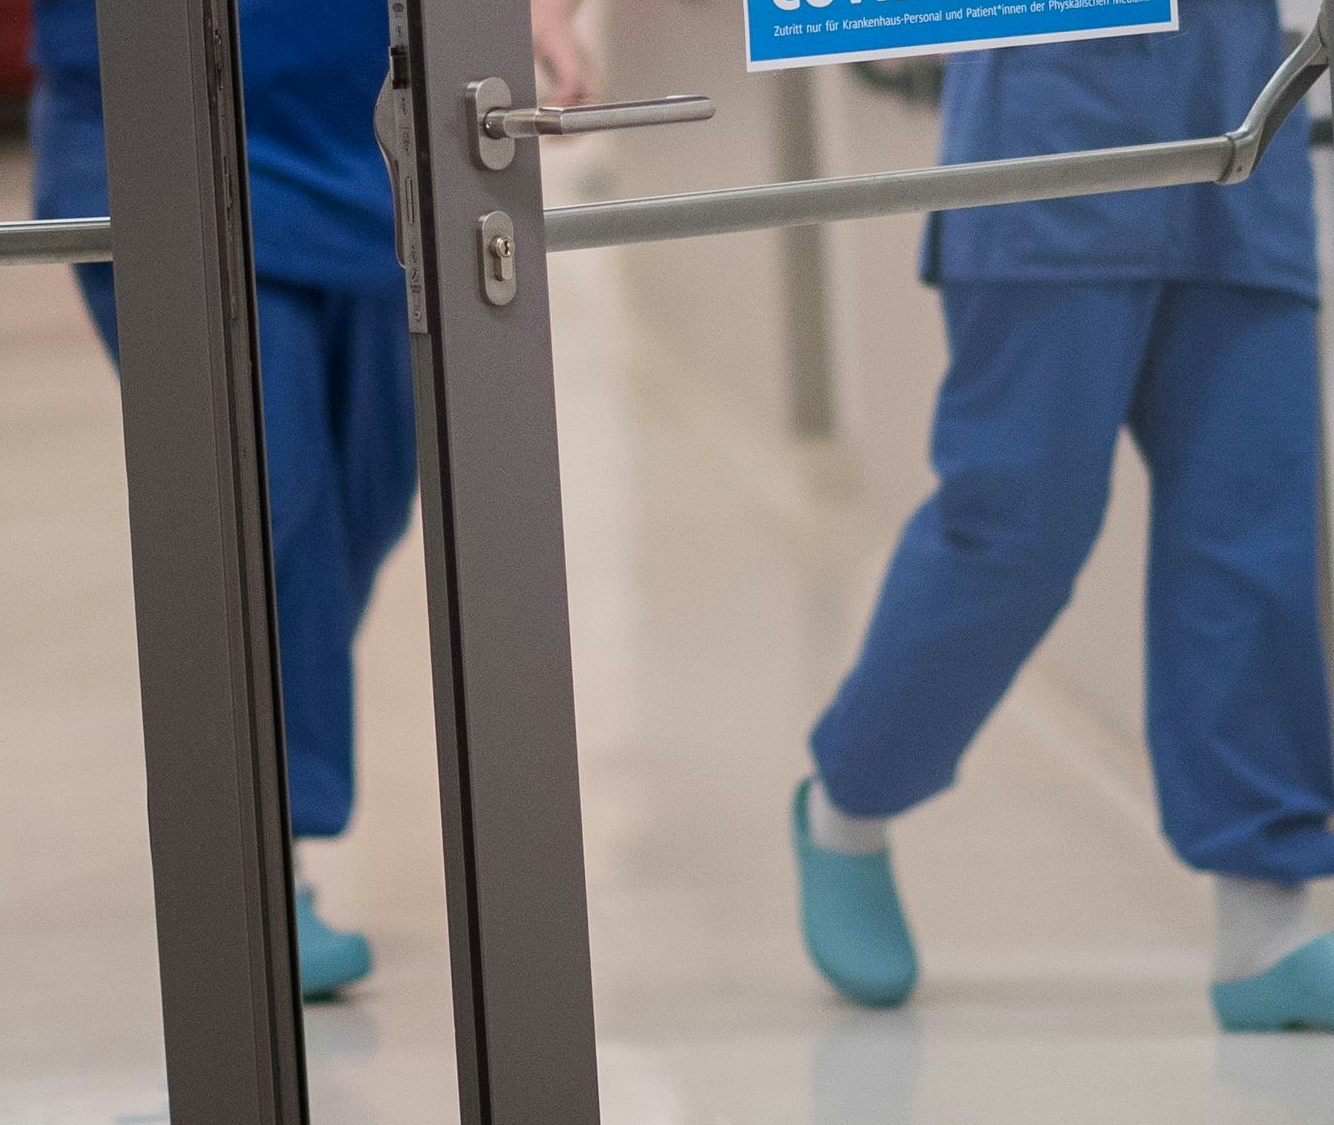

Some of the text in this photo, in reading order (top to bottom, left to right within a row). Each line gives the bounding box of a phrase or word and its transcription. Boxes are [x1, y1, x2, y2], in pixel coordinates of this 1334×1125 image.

[774, 25, 803, 37] Zutritt
[807, 23, 822, 33] nur
[826, 20, 839, 32] für
[843, 11, 942, 29] Krankenhaus-Personal
[946, 8, 963, 20] und
[1030, 1, 1045, 12] der
